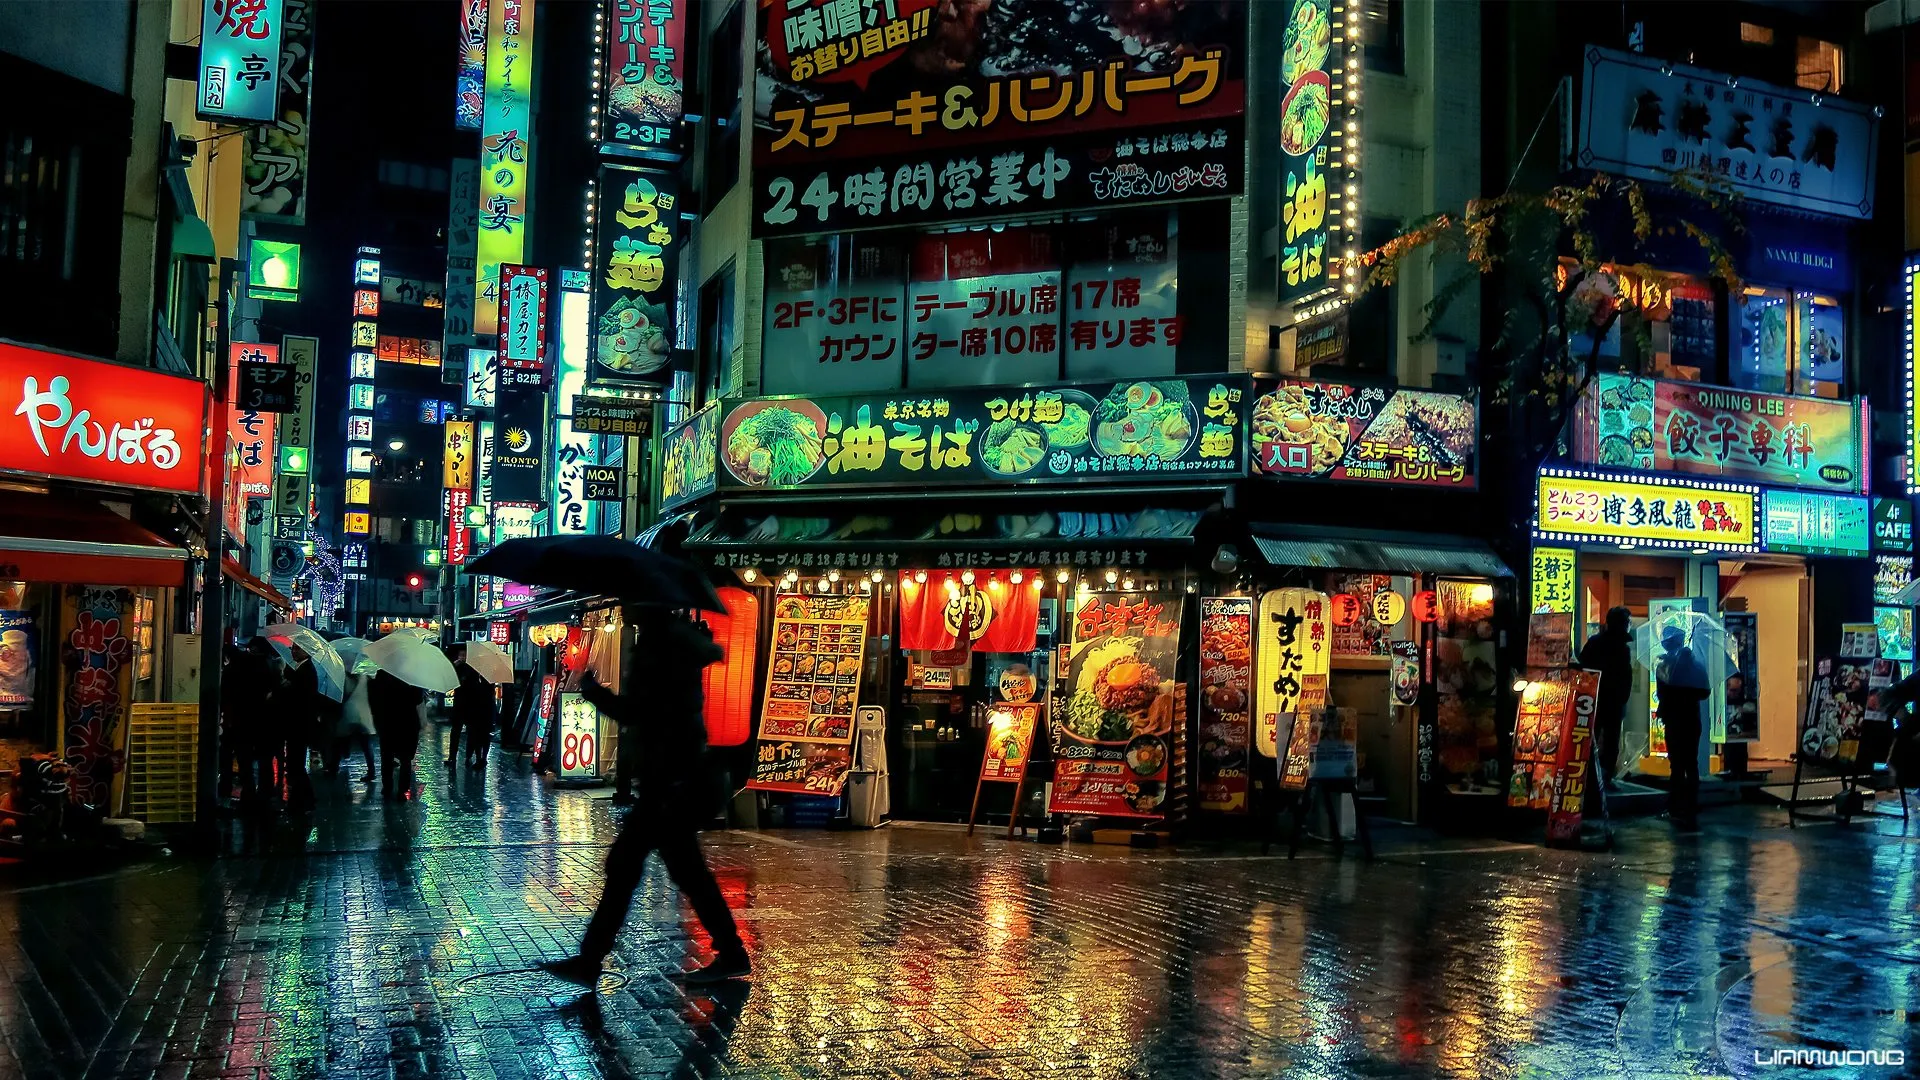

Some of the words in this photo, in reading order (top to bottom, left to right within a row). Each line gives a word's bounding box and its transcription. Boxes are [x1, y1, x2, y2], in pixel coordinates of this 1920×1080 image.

[618, 0, 647, 84] ンバーグ
[790, 19, 931, 82] お替り自由!!
[207, 70, 222, 106] 三八九
[771, 50, 1223, 153] ステーキ&ハンバーグ
[1662, 148, 1802, 188] 四川料理達人の店
[480, 130, 526, 234] 花の宴
[764, 147, 1072, 225] 24時間営業中
[1281, 152, 1327, 287] 油そば
[1766, 247, 1801, 265] NANAE
[773, 297, 897, 330] 2F・3Fに
[913, 286, 1057, 323] テーブル席
[1071, 277, 1142, 311] 17席
[512, 281, 536, 357] 椿屋カフェ
[818, 335, 896, 363] カウン
[912, 324, 1057, 361] ター席10席
[1070, 316, 1186, 349] 有ります
[250, 367, 287, 384] モア
[502, 369, 515, 377] 2F
[502, 378, 515, 386] 3F
[516, 372, 542, 386] 82席
[574, 407, 636, 420] ライス&味噌汁
[883, 398, 950, 420] 東京名物
[984, 391, 1064, 423] つけ麺
[1303, 384, 1372, 419] すためし
[1698, 391, 1752, 412] DINING
[1758, 399, 1785, 416] LEE
[14, 375, 181, 470] やんばる
[574, 417, 649, 434] お替り自由!!
[1199, 384, 1238, 459] らぁ麺
[823, 404, 979, 474] 油そば
[1359, 440, 1432, 463] ステーキ&
[1665, 409, 1816, 471] 餃子専科
[497, 456, 539, 466] PRONTO
[1267, 445, 1308, 468] 入口
[586, 470, 616, 481] MOA
[1345, 468, 1392, 480] お替り自由!!
[1394, 462, 1466, 484] ハンバーグ
[557, 442, 588, 531] かぶら屋
[587, 484, 605, 498] 3rd
[1547, 489, 1599, 506] とんこつ
[280, 517, 302, 527] モア
[1547, 506, 1599, 523] ラーメン
[1600, 495, 1697, 529] 博多風龍
[1887, 504, 1901, 521] 4F
[1874, 521, 1912, 539] CAFE
[1543, 557, 1560, 601] 替玉
[1561, 559, 1573, 602] ラーメン
[1305, 600, 1325, 653] 情熱の
[562, 733, 595, 771] 80
[758, 742, 801, 762] 地下に
[584, 764, 595, 775] 円
[804, 775, 838, 793] 24h
